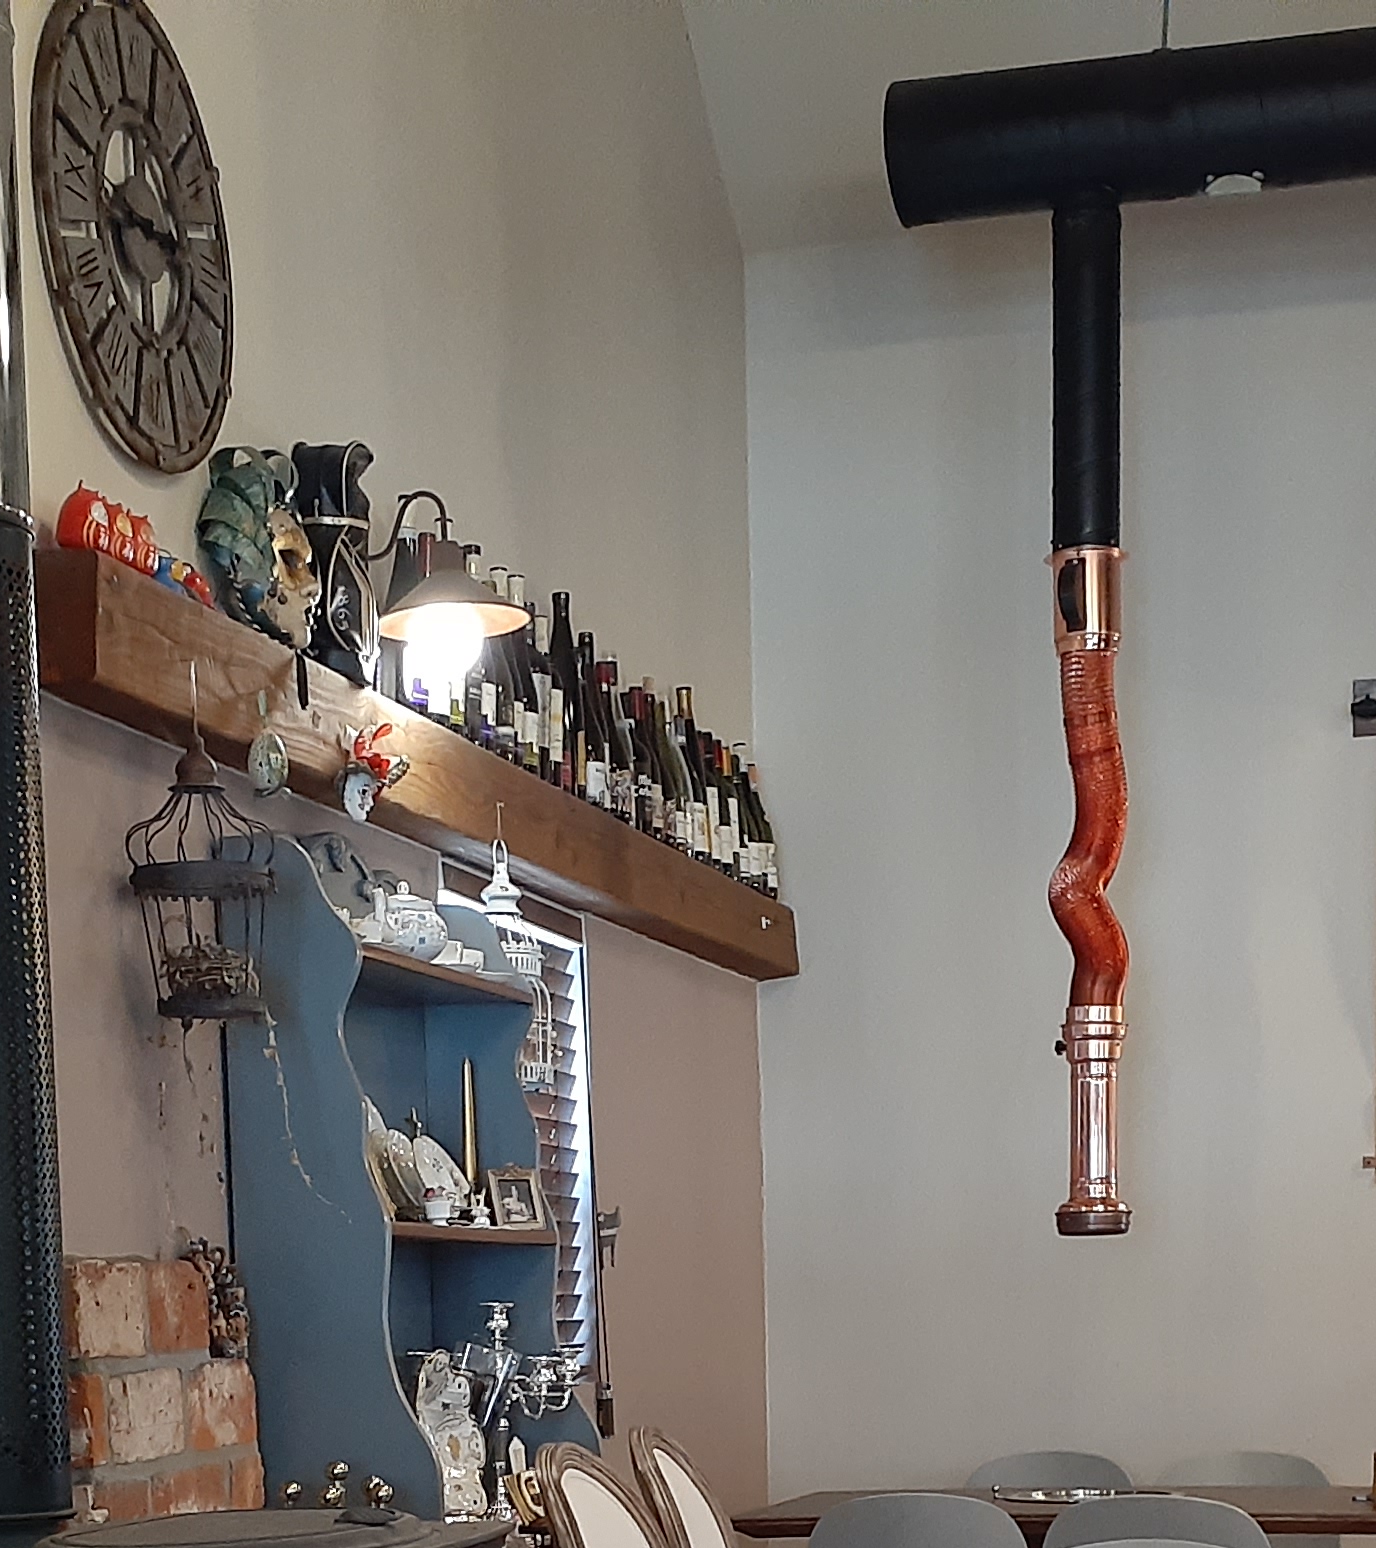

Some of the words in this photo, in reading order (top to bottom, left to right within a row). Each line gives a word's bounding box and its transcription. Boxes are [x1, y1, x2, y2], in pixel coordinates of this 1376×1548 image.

[63, 151, 89, 202] IX
[77, 247, 105, 308] VIII
[199, 252, 219, 294] III
